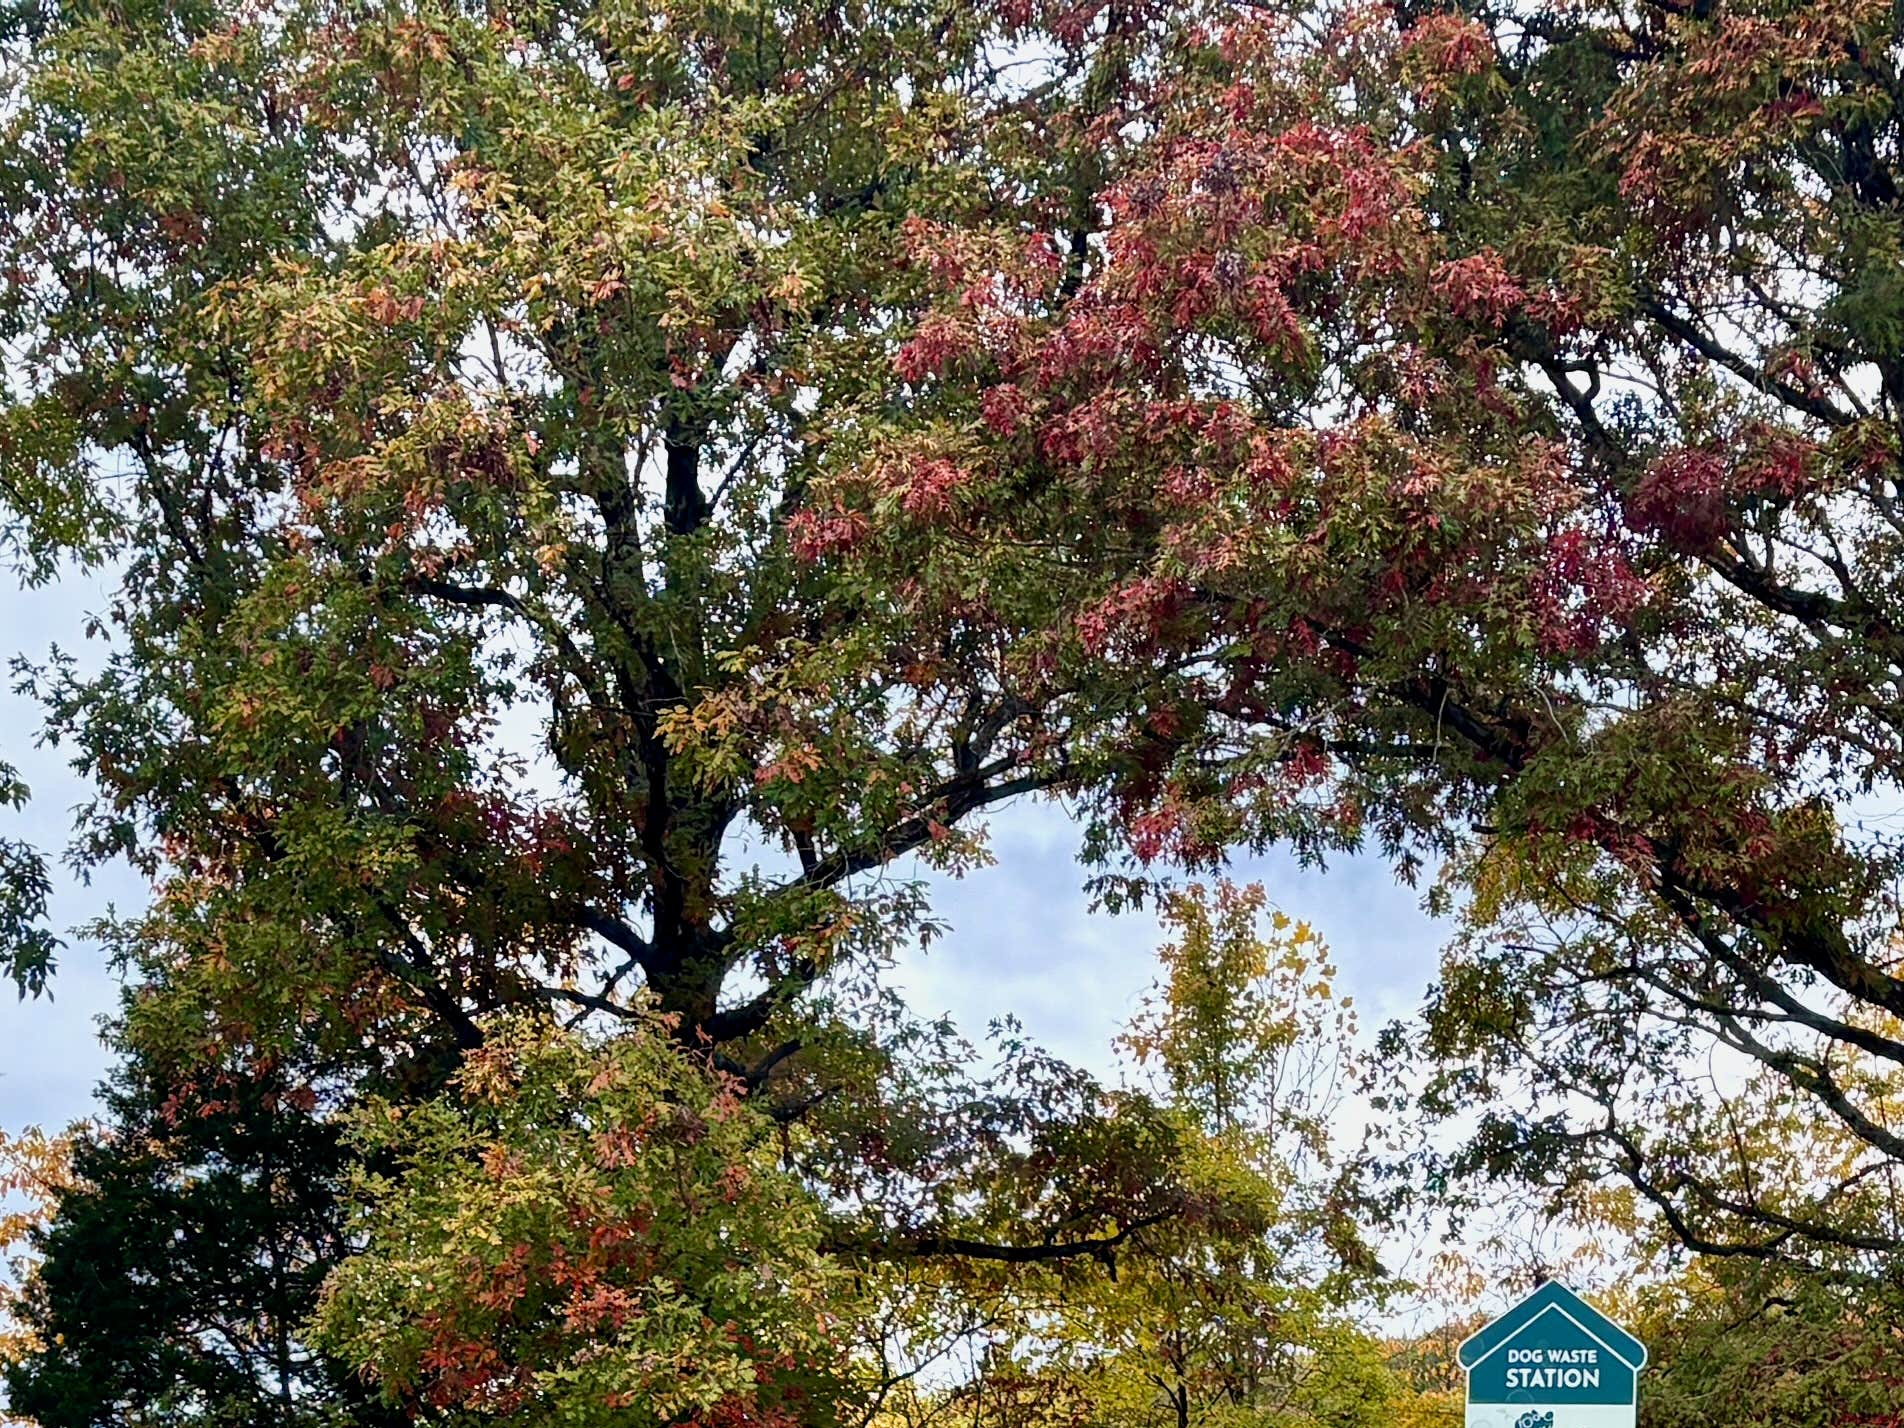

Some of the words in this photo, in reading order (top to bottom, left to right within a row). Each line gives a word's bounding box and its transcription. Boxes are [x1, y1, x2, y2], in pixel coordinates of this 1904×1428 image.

[1508, 1350, 1543, 1363] DOG
[1546, 1350, 1597, 1363] WASTE
[1506, 1368, 1600, 1388] STATION
